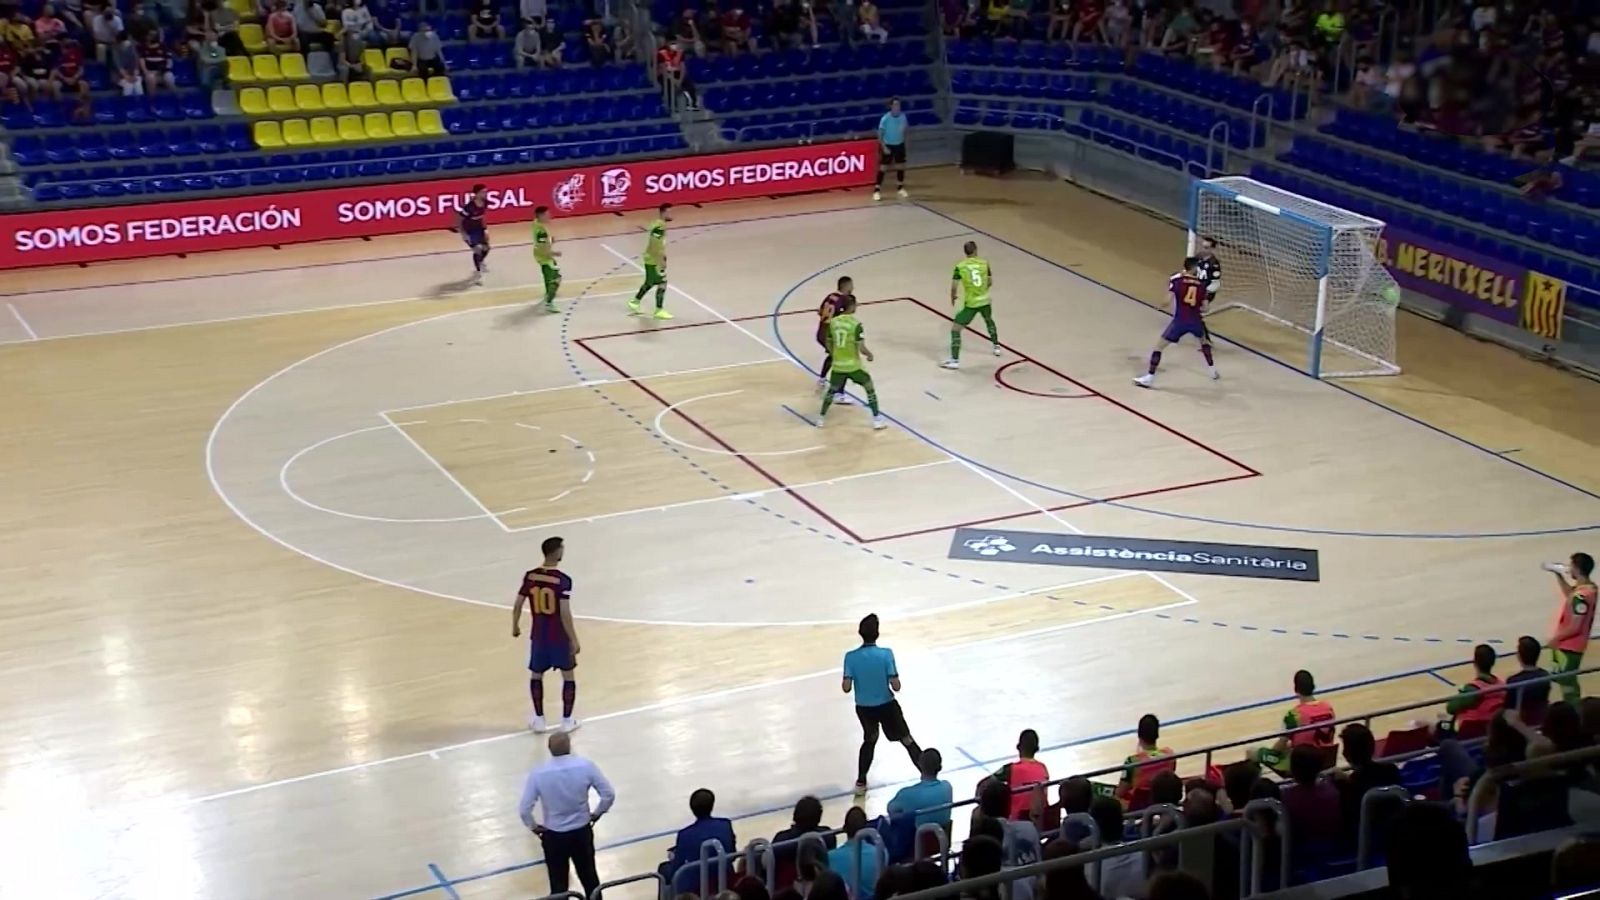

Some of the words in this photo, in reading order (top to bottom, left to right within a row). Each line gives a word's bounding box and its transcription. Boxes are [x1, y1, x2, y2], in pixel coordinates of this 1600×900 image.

[645, 168, 725, 194] SOMOS
[729, 152, 865, 185] FEDERACIÓN
[338, 196, 431, 222] SOMOS
[438, 188, 533, 213] FUSAL
[15, 223, 121, 251] SOMOS
[127, 204, 301, 242] FEDERACIÓN
[971, 269, 983, 287] 5
[1396, 243, 1518, 308] MERITXELL
[1184, 286, 1197, 307] 4
[529, 586, 556, 615] 10
